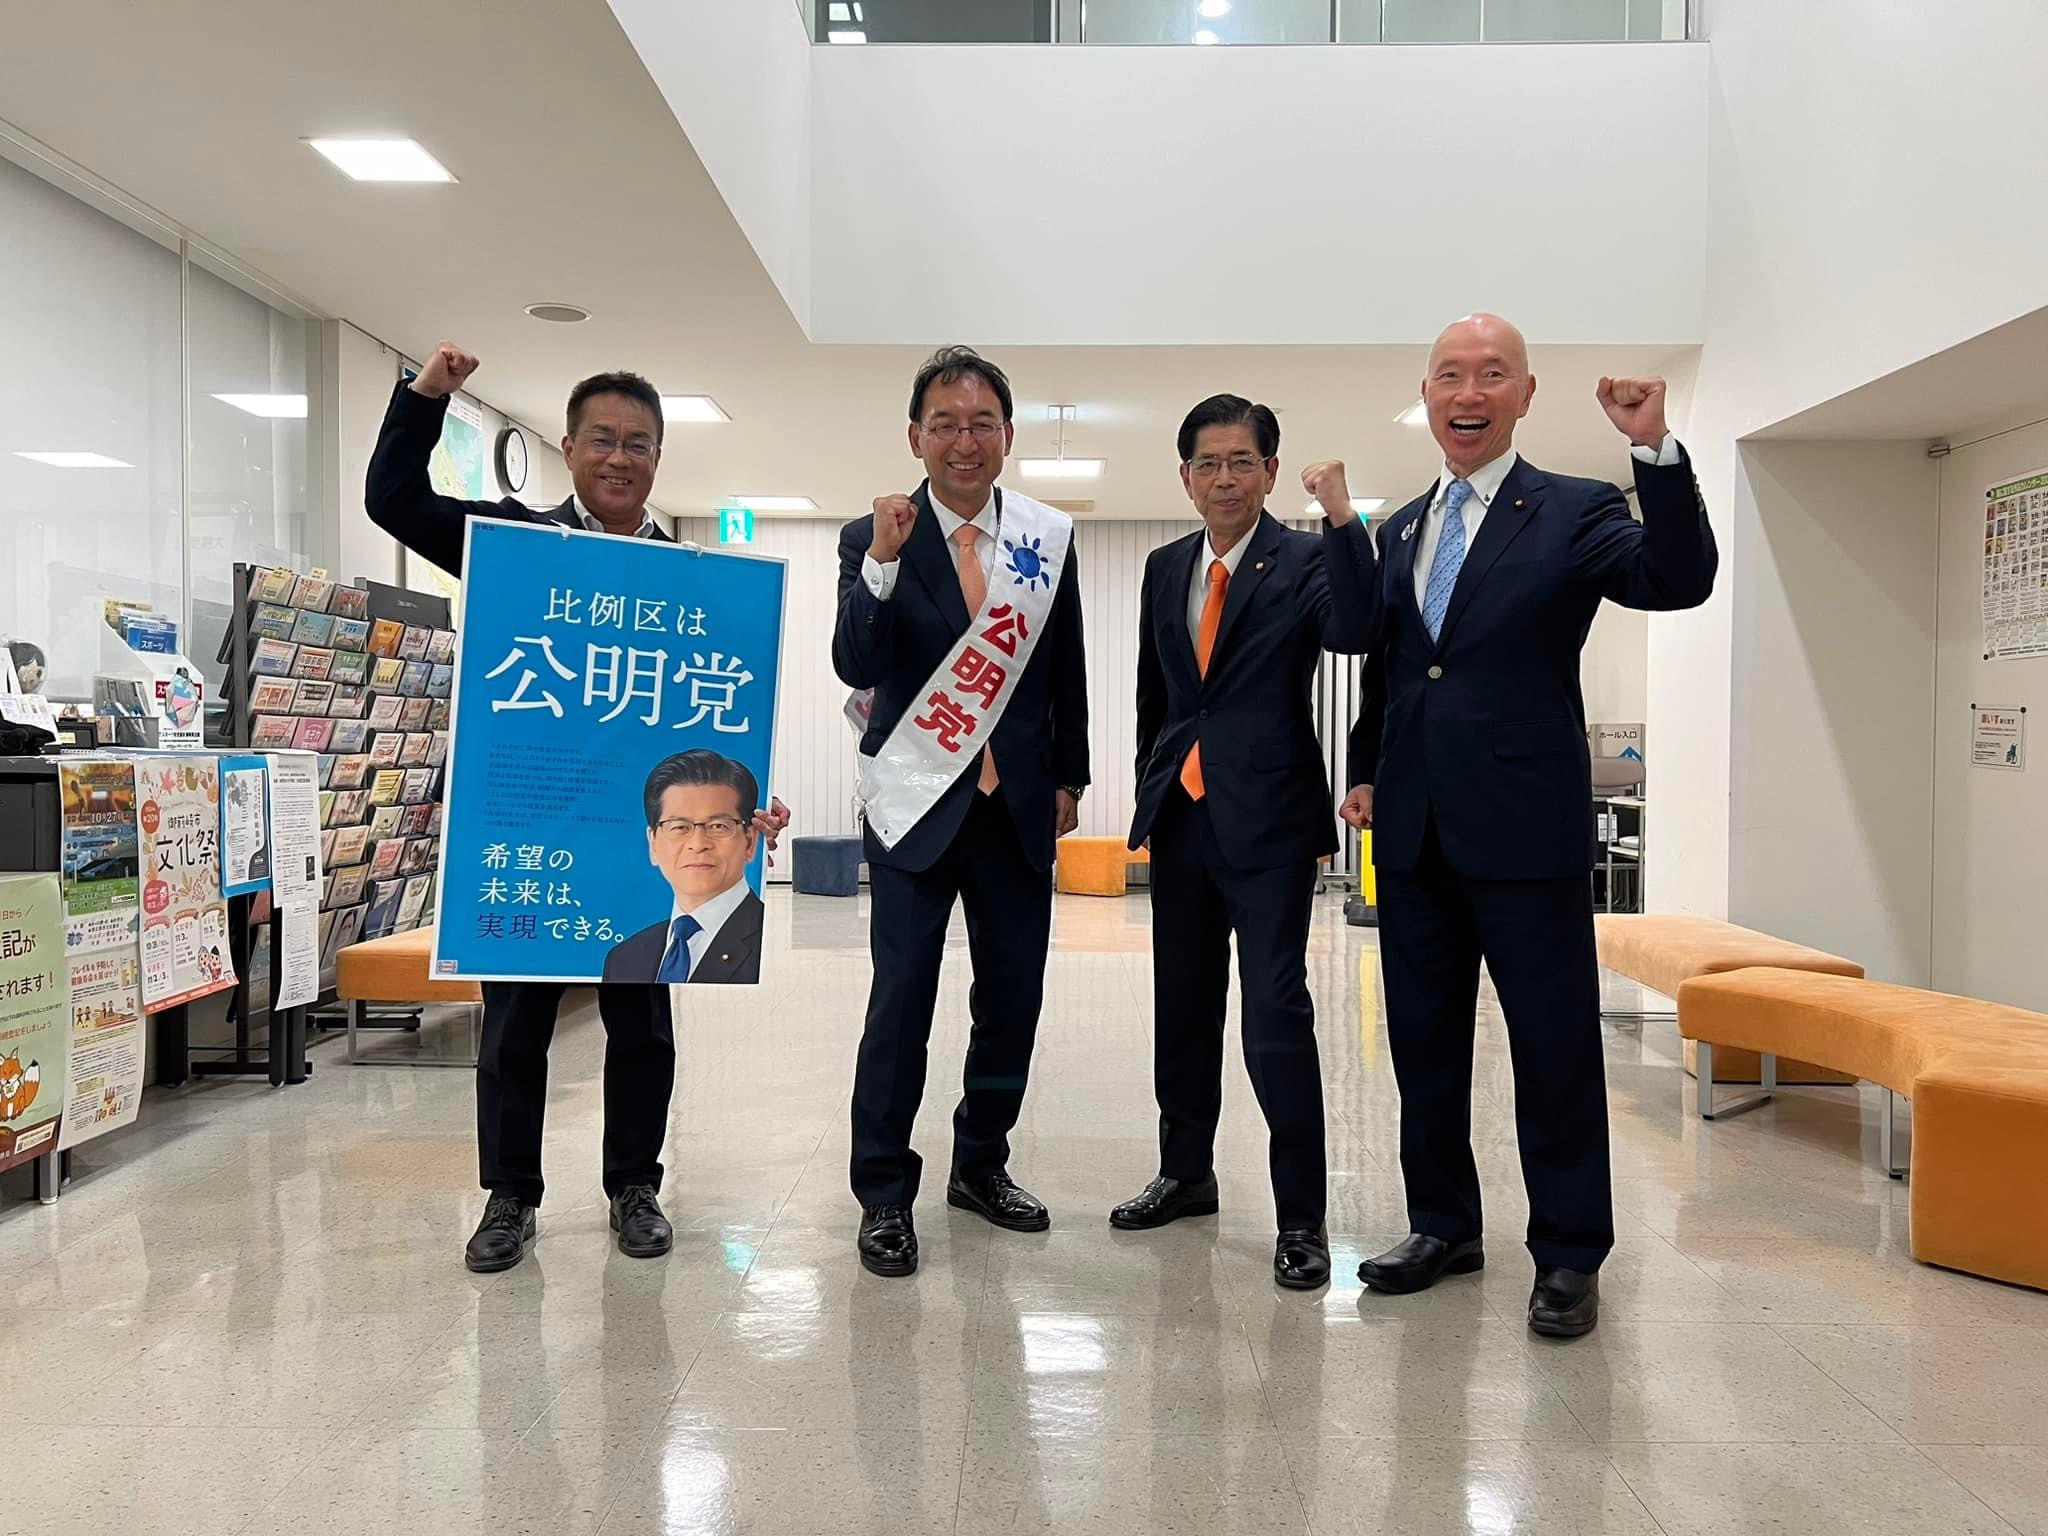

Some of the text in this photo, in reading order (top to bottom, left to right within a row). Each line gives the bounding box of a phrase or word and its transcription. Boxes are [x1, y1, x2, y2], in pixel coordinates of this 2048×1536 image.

[543, 587, 708, 637] 比例区は
[141, 640, 165, 650] スポーツ
[484, 635, 755, 733] 公明党
[913, 602, 1030, 754] 公明党
[1599, 730, 1637, 739] ホール入口
[157, 829, 216, 873] 文化祭
[481, 842, 574, 872] 希望の
[478, 877, 582, 907] 未来は、
[0, 908, 22, 921] 日から
[476, 912, 626, 944] 実現できる。
[0, 929, 37, 960] 記が
